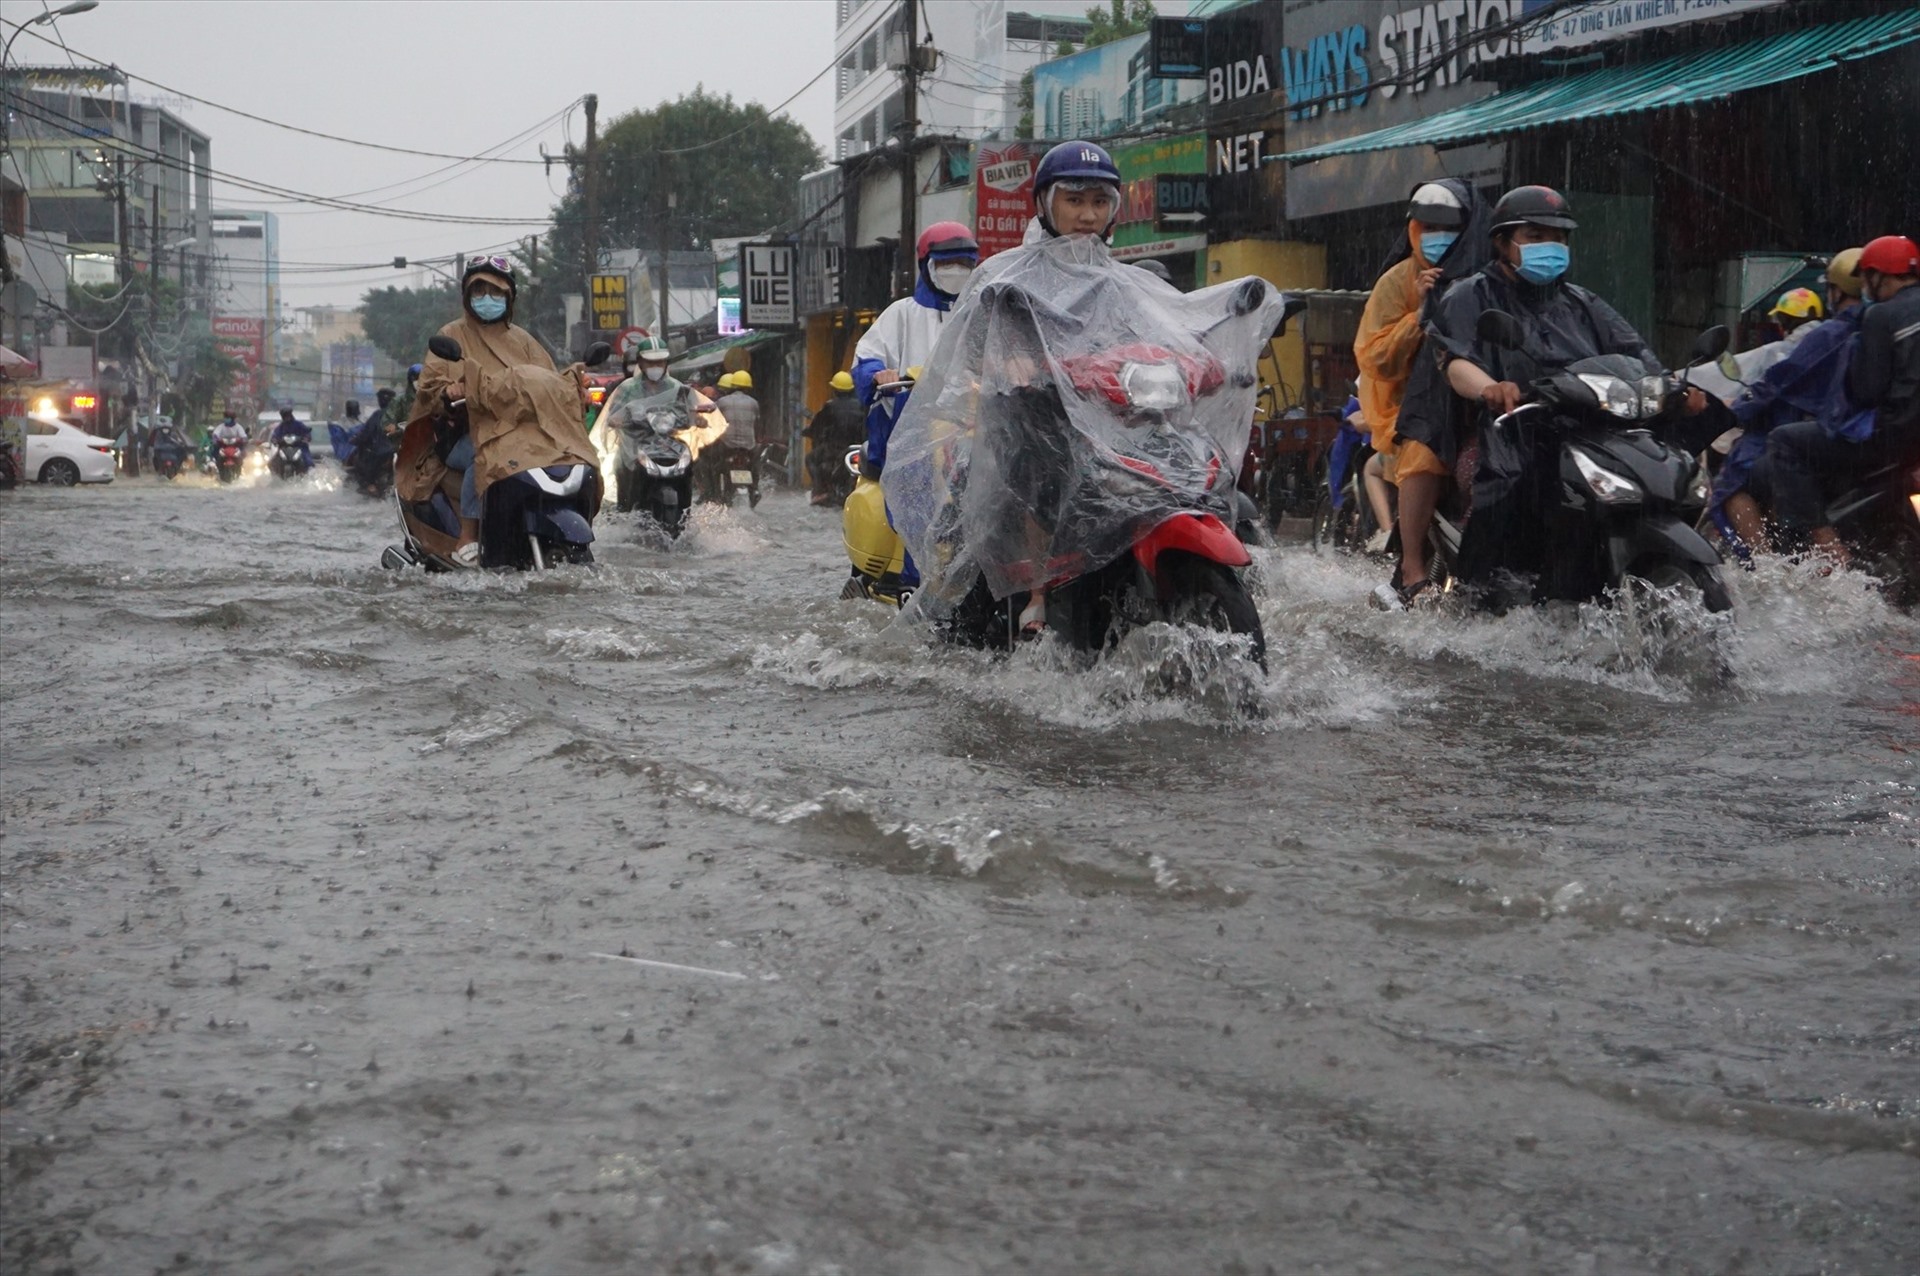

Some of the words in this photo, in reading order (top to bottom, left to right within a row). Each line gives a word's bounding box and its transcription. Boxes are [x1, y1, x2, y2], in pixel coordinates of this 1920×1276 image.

[1563, 17, 1578, 37] 47
[1209, 54, 1270, 105] BIDA
[1281, 23, 1369, 121] WAYS
[1080, 148, 1100, 162] ila
[1216, 131, 1264, 176] NET
[986, 168, 1006, 183] BIA
[1158, 181, 1211, 209] BIDA
[979, 213, 994, 231] CÔ
[997, 215, 1017, 232] GÁI
[749, 250, 788, 276] LU
[593, 276, 625, 294] IN
[750, 279, 789, 305] WE
